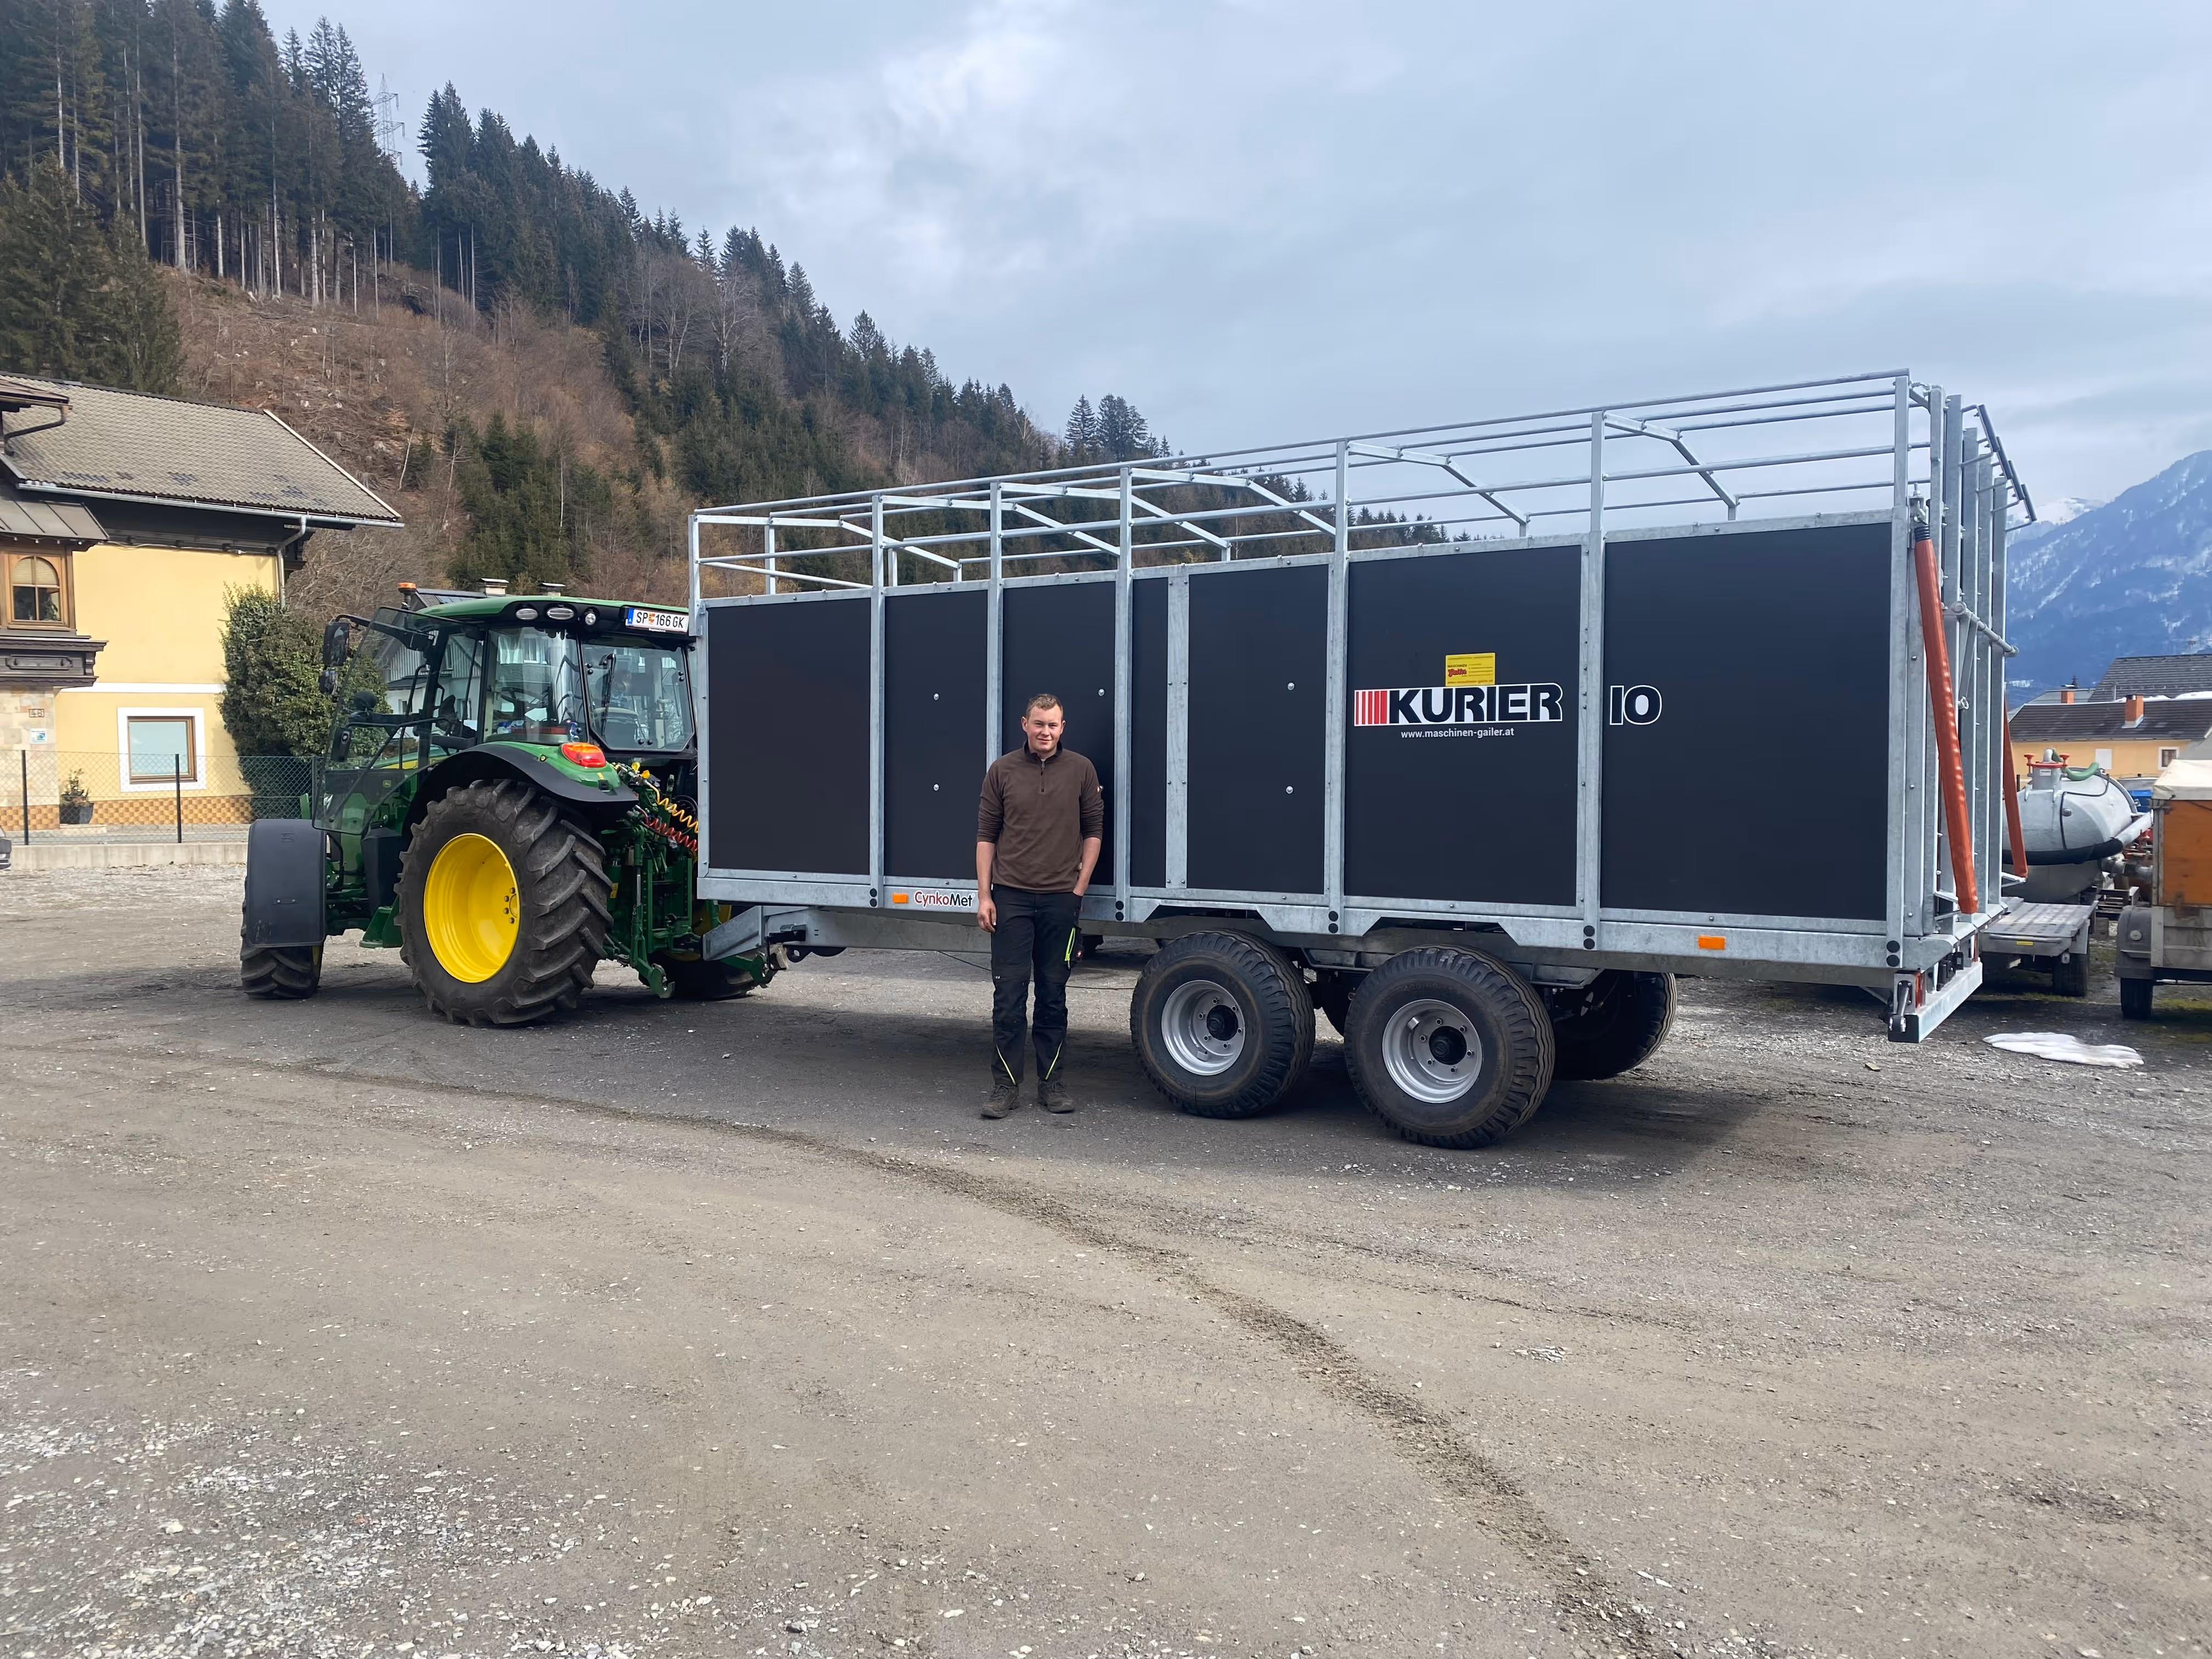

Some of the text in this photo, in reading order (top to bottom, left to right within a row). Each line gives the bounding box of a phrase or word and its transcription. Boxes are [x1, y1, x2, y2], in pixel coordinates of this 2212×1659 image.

[636, 611, 685, 628] SP 166 GK
[1389, 683, 1563, 725] KURIER
[1401, 727, 1515, 738] www.maschinen-gailer.at
[915, 891, 973, 907] CynkoMet
